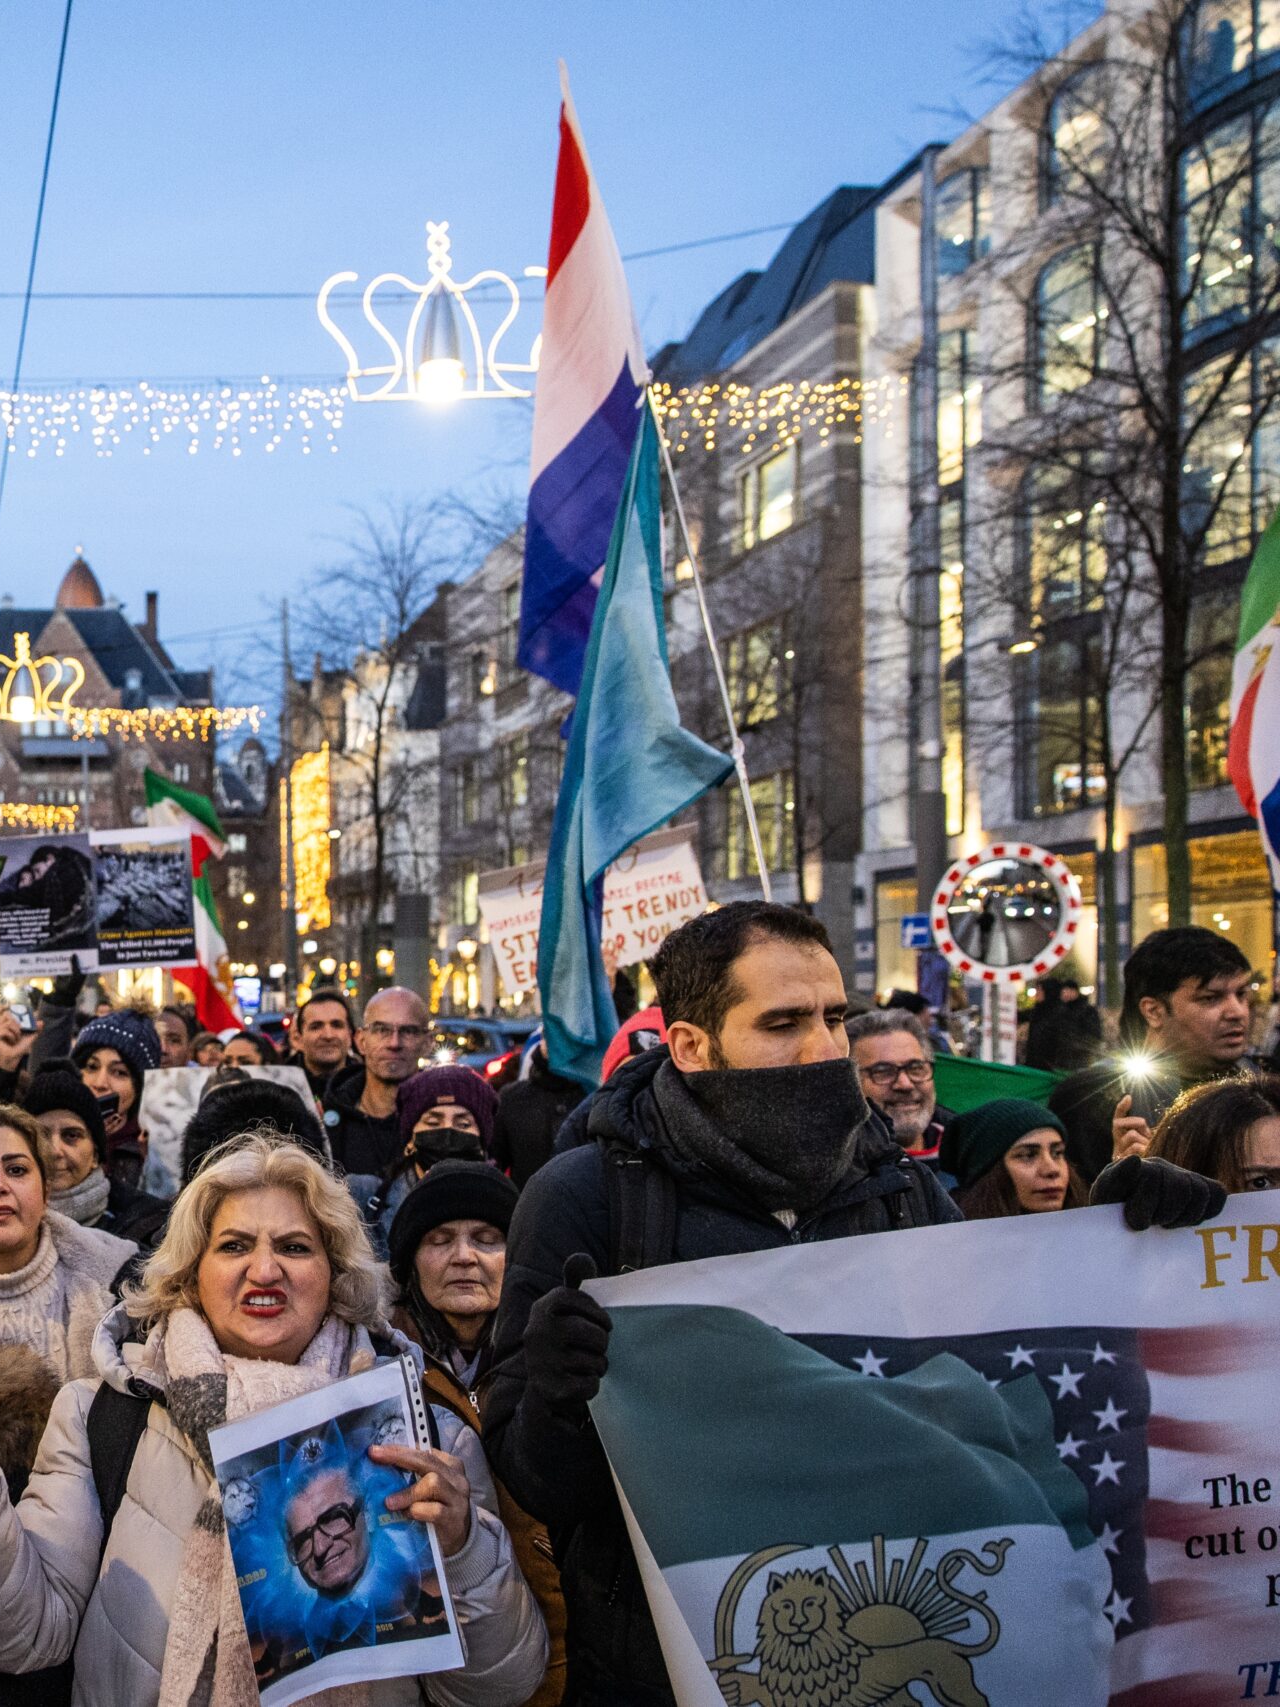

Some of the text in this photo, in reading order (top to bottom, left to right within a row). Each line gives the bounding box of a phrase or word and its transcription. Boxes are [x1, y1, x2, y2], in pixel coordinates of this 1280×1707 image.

[622, 885, 701, 924] TRENDY
[1203, 1473, 1271, 1509] The
[1185, 1526, 1245, 1559] cut
